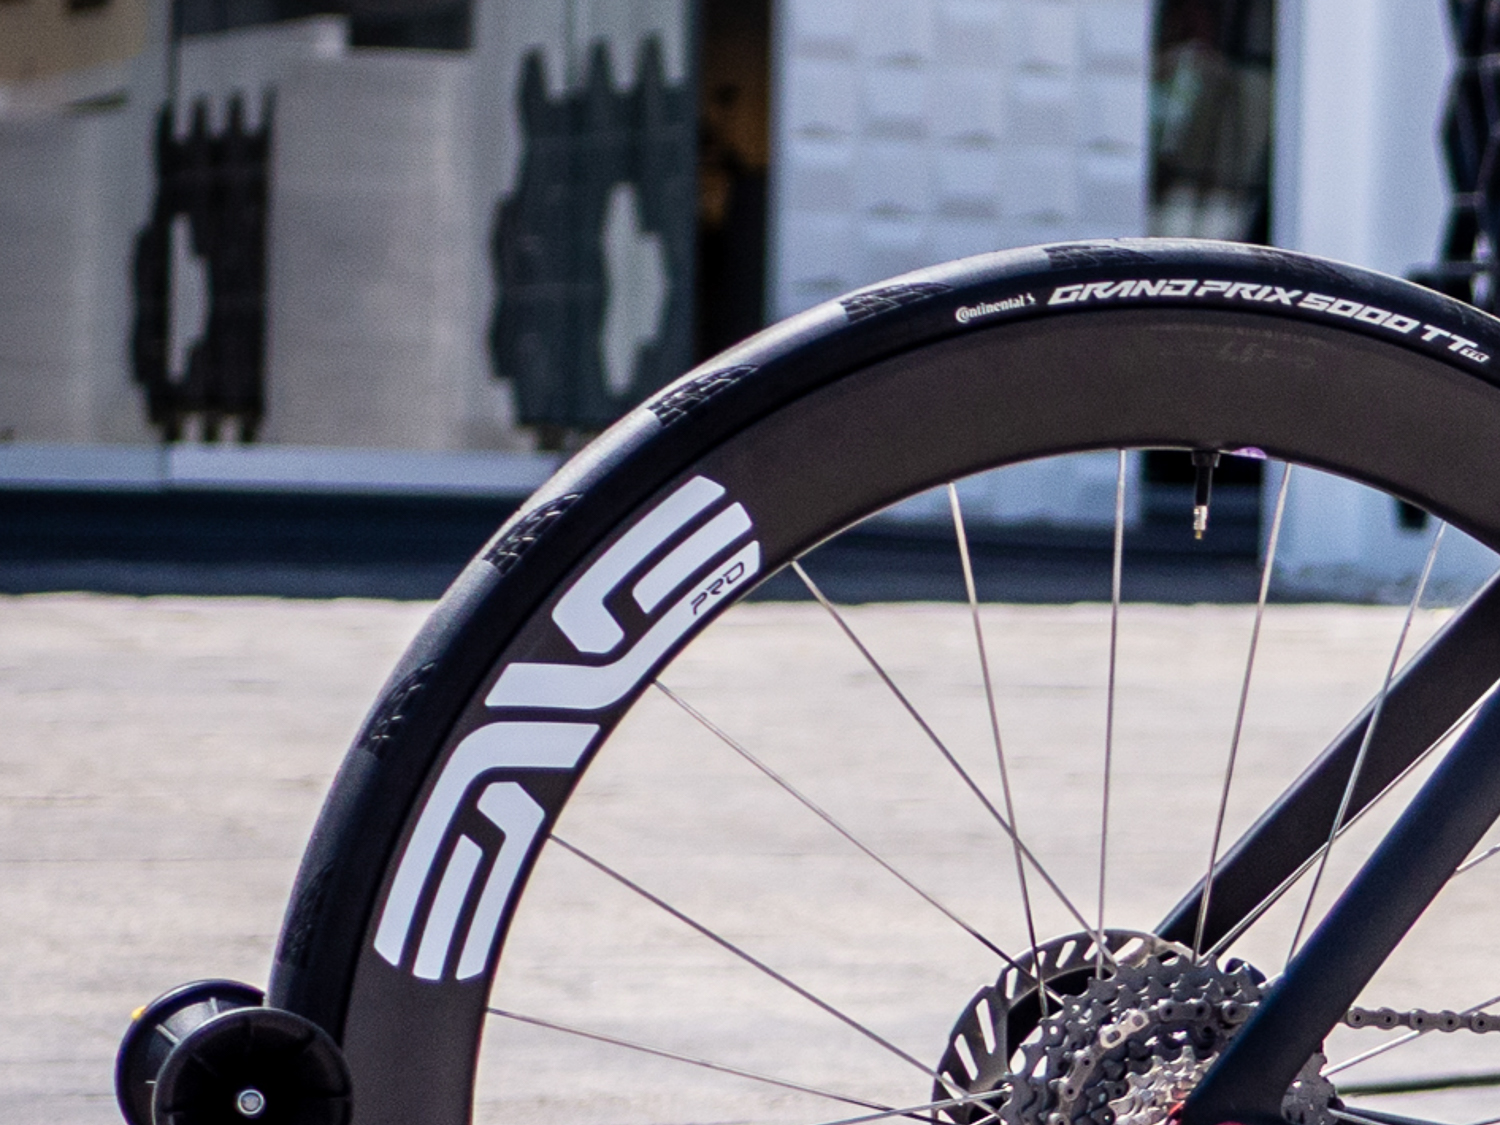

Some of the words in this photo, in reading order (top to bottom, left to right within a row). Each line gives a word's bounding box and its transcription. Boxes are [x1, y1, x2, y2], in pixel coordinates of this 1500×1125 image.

[1047, 278, 1192, 305] GRAND
[1194, 279, 1302, 308] PRIX
[1297, 292, 1421, 334] 5000
[1420, 324, 1479, 352] TT
[690, 561, 745, 616] PRO
[374, 475, 760, 980] ENVE
